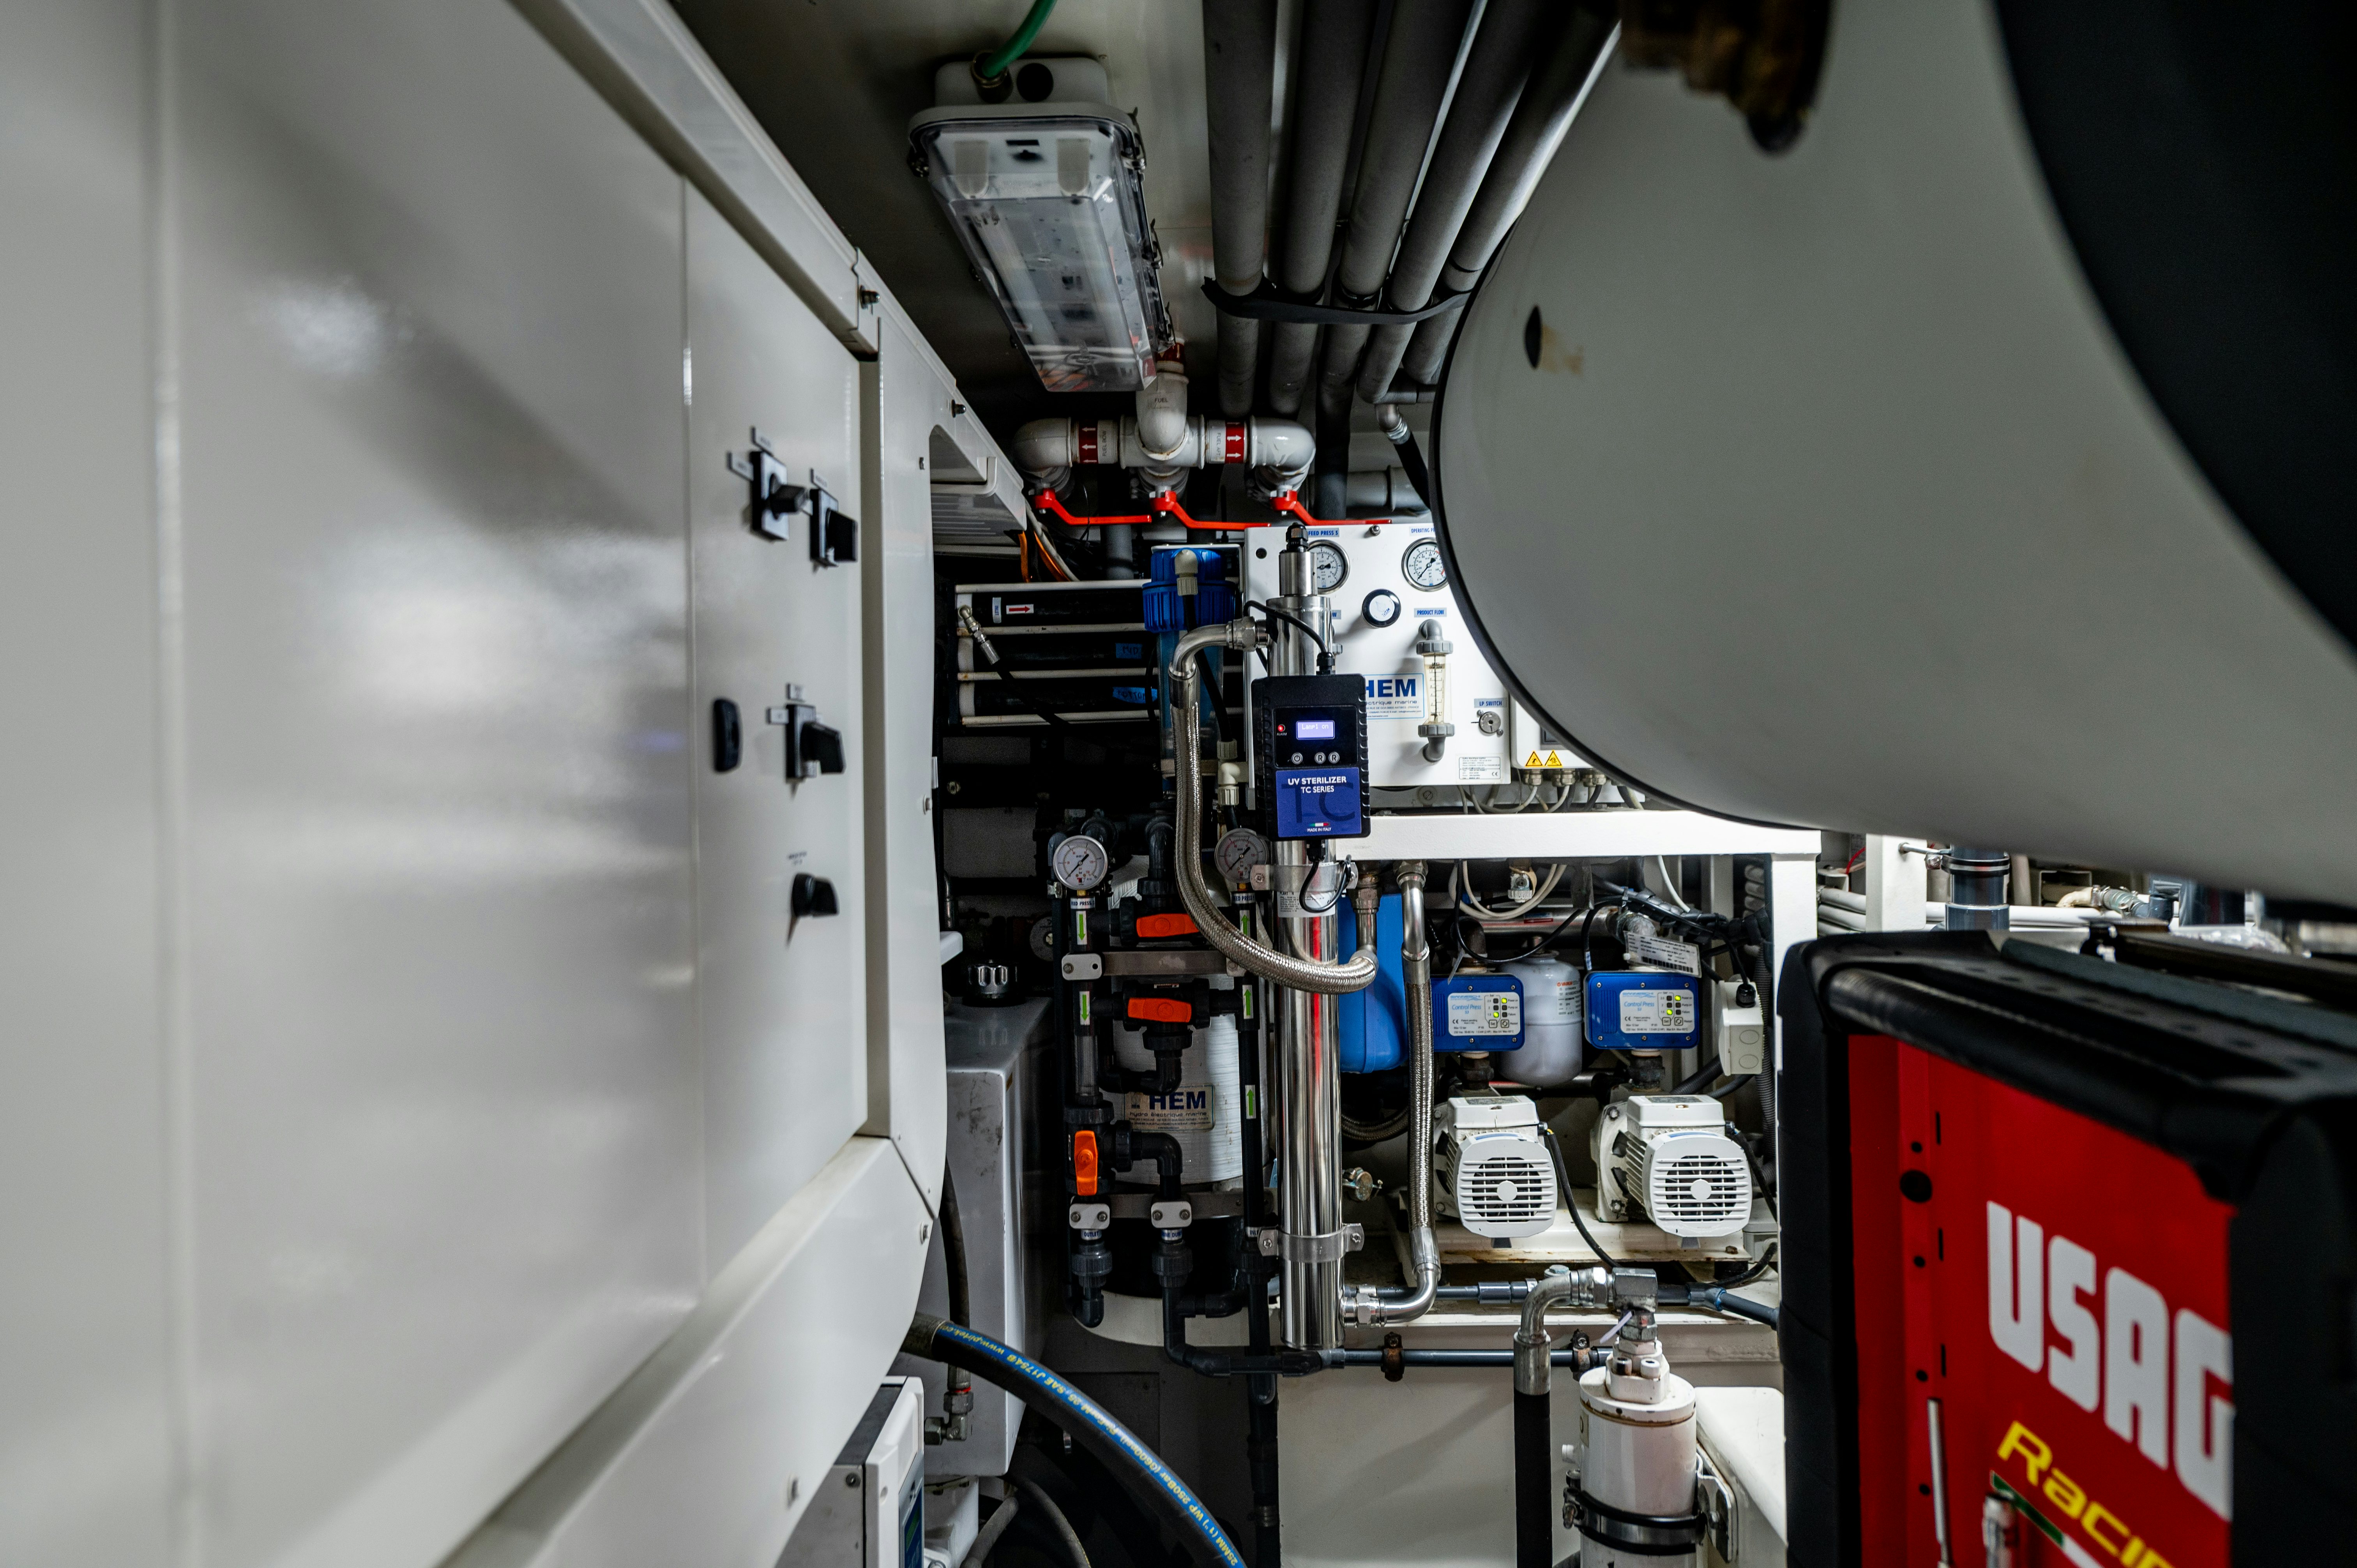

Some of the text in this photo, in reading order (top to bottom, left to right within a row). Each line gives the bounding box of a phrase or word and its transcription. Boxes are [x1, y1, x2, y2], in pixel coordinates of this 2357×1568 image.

[1366, 679, 1416, 697] HEM
[1302, 776, 1347, 785] STERILIZER
[1149, 1091, 1206, 1110] HEM
[1986, 1200, 2236, 1522] USAG
[1044, 1376, 1066, 1394] SAE
[1160, 1472, 1191, 1504] 250Bar
[1188, 1504, 1204, 1521] WP
[1216, 1536, 1238, 1566] 25MM
